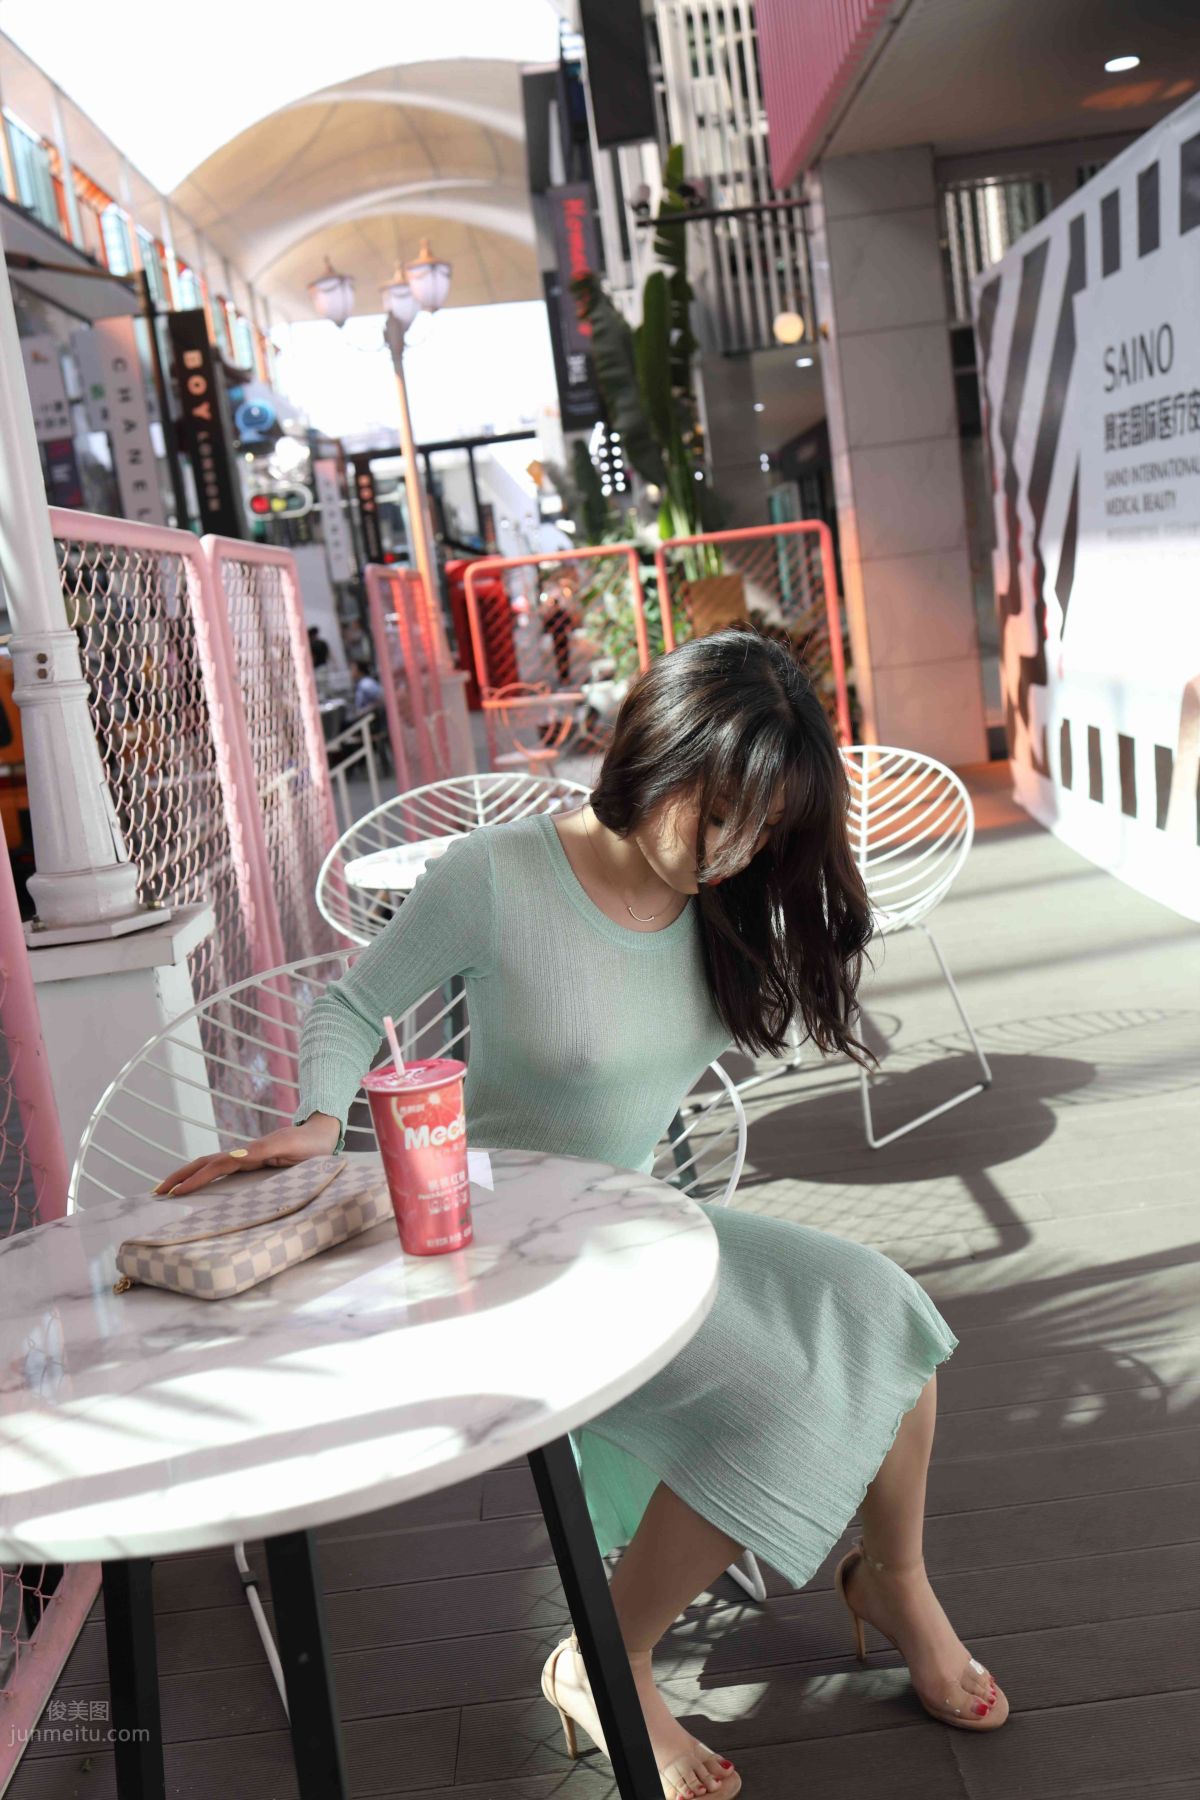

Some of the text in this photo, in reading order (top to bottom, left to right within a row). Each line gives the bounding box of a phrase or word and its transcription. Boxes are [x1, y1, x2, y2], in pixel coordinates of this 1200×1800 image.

[182, 350, 212, 421] BOY
[1104, 323, 1174, 393] SAINO
[112, 356, 151, 520] CHANEL
